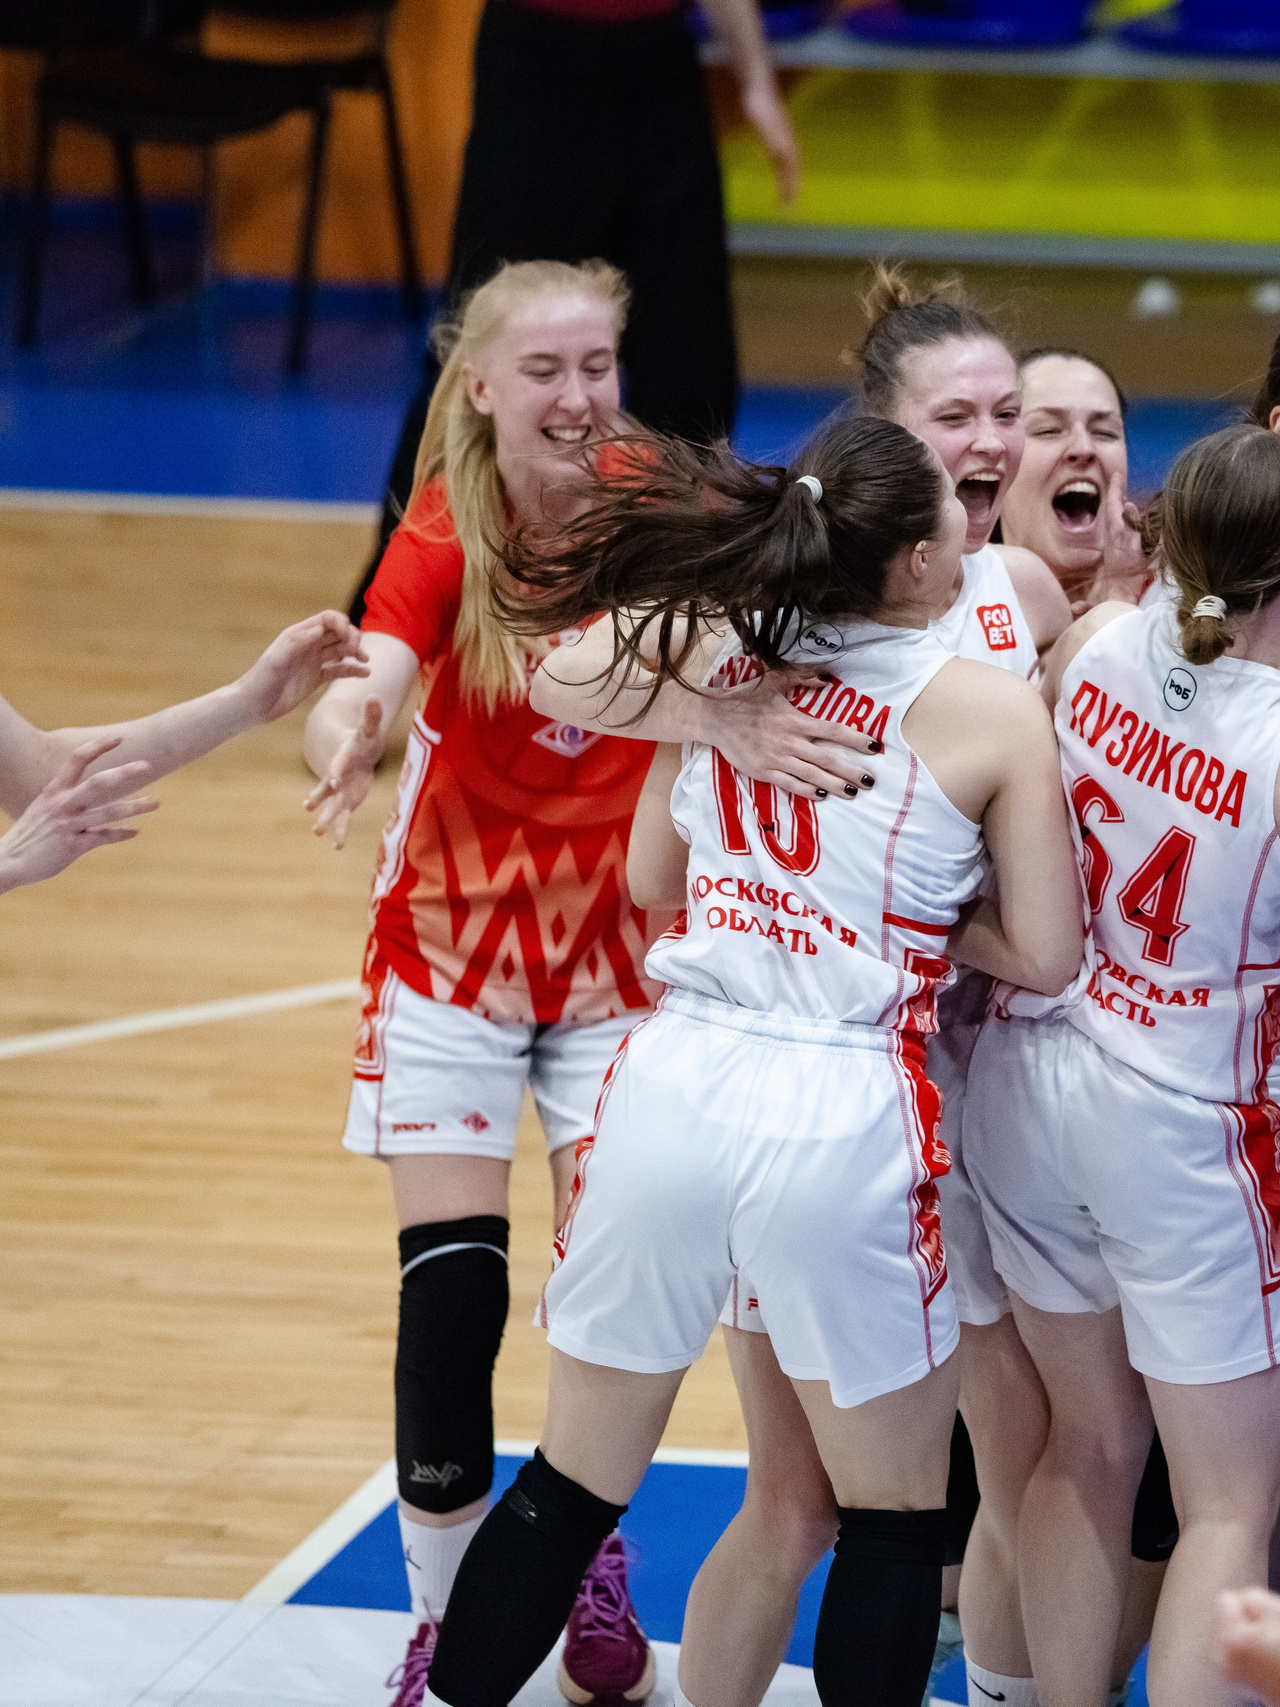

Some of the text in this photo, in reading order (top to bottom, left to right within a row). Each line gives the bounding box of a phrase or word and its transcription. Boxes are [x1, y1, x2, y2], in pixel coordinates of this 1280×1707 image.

[1169, 678, 1192, 700] РФБ
[1070, 680, 1248, 828] ПУЗИКОВА
[1072, 774, 1197, 967] 64
[707, 906, 818, 956] ОБЛАТЬ
[1095, 949, 1211, 1007] ОВСКАЯ
